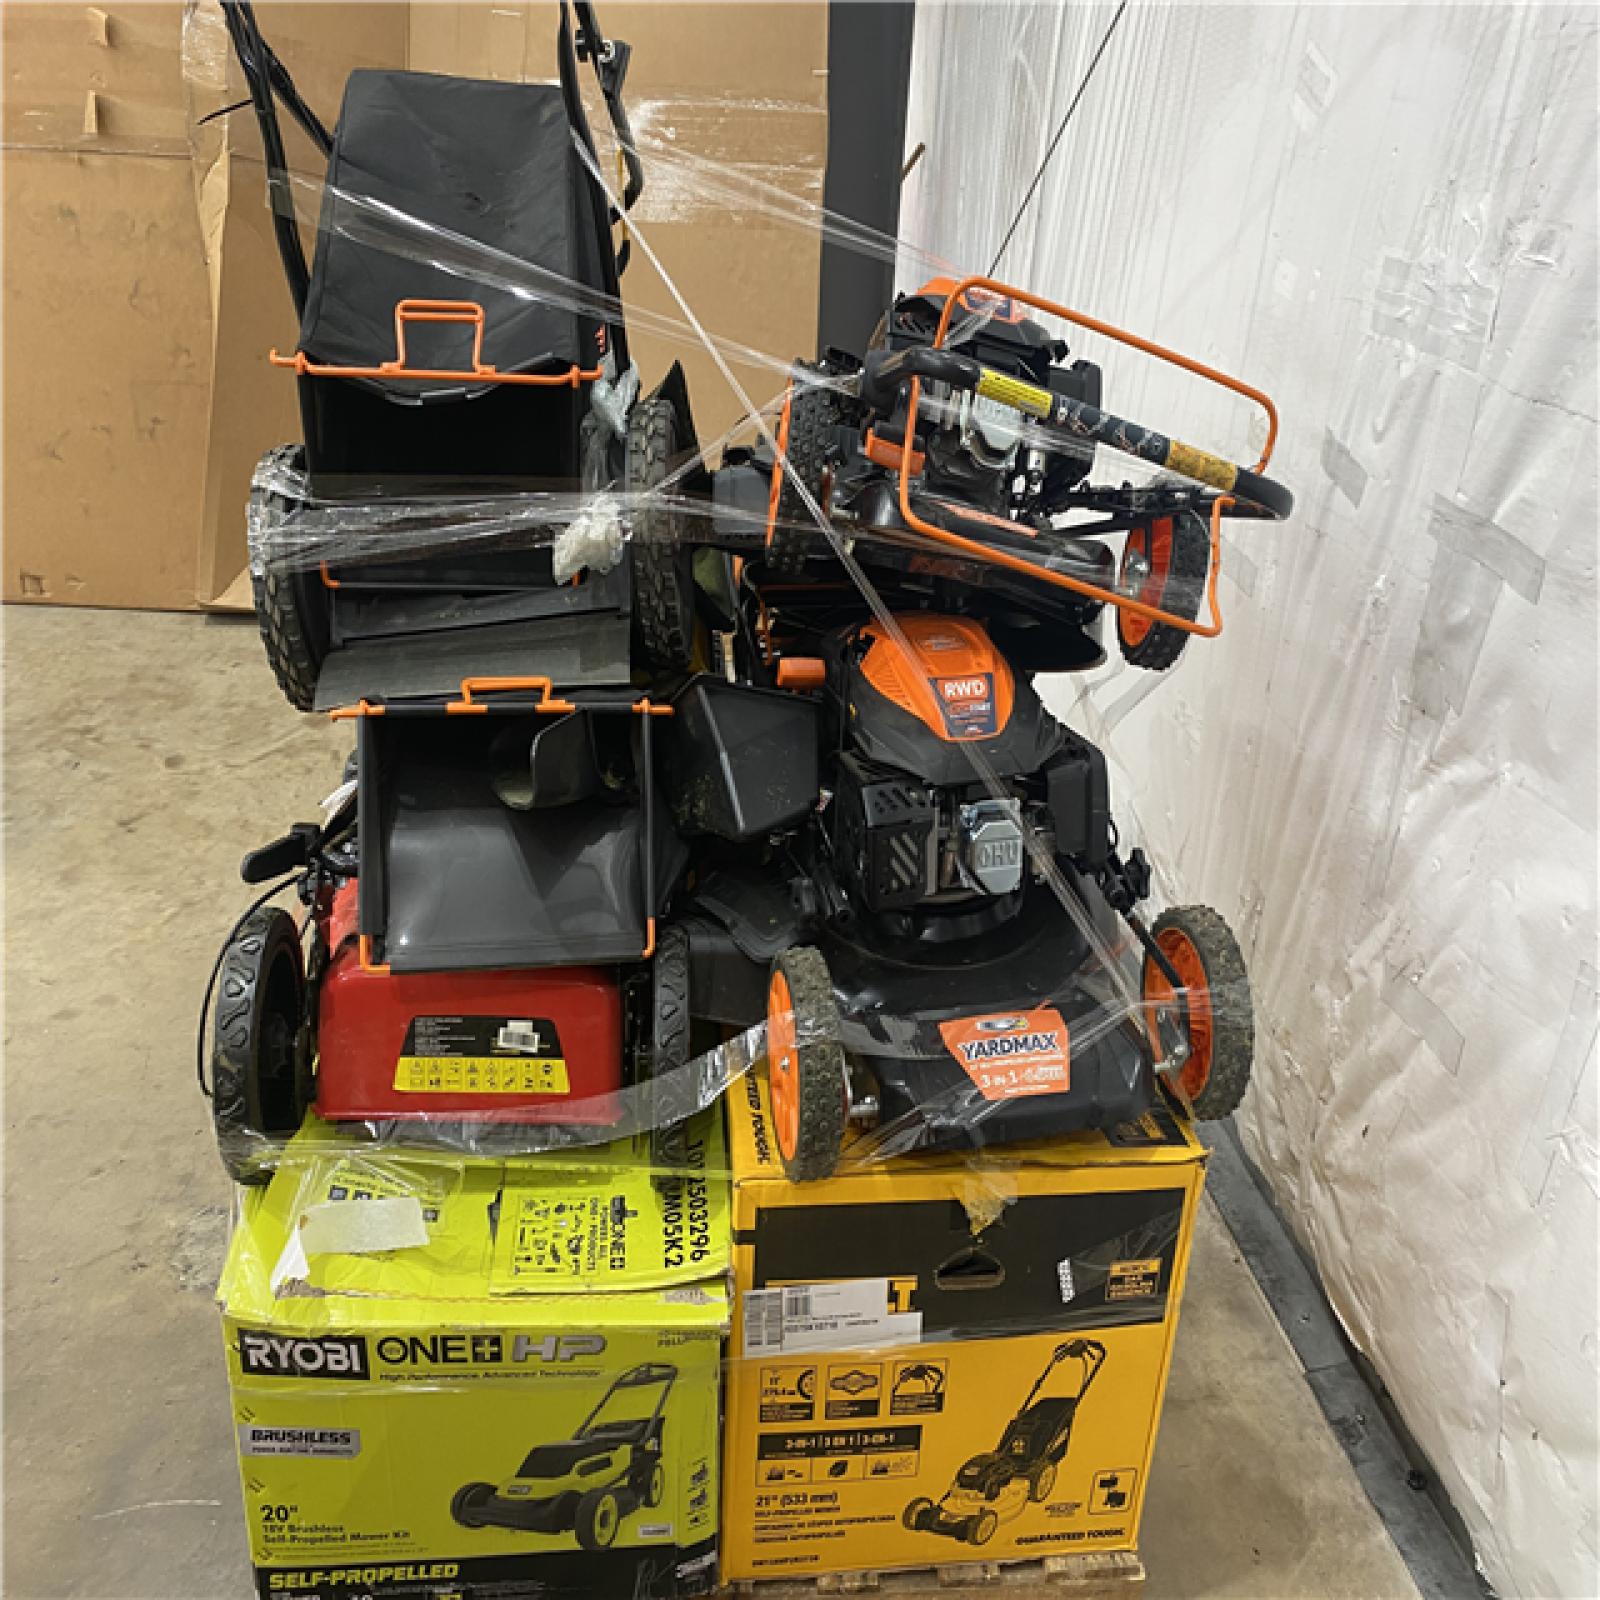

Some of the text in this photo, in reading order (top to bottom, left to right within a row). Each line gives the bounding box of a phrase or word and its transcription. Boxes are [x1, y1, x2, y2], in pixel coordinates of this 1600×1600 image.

[944, 679, 986, 698] RWD
[958, 1031, 1058, 1061] YARDMAX
[244, 1336, 361, 1372] RYOBI
[511, 1334, 607, 1363] HP
[251, 1429, 351, 1445] BRUSHLESS
[259, 1503, 299, 1523] 20"
[268, 1563, 461, 1590] SELF-PROPELLED
